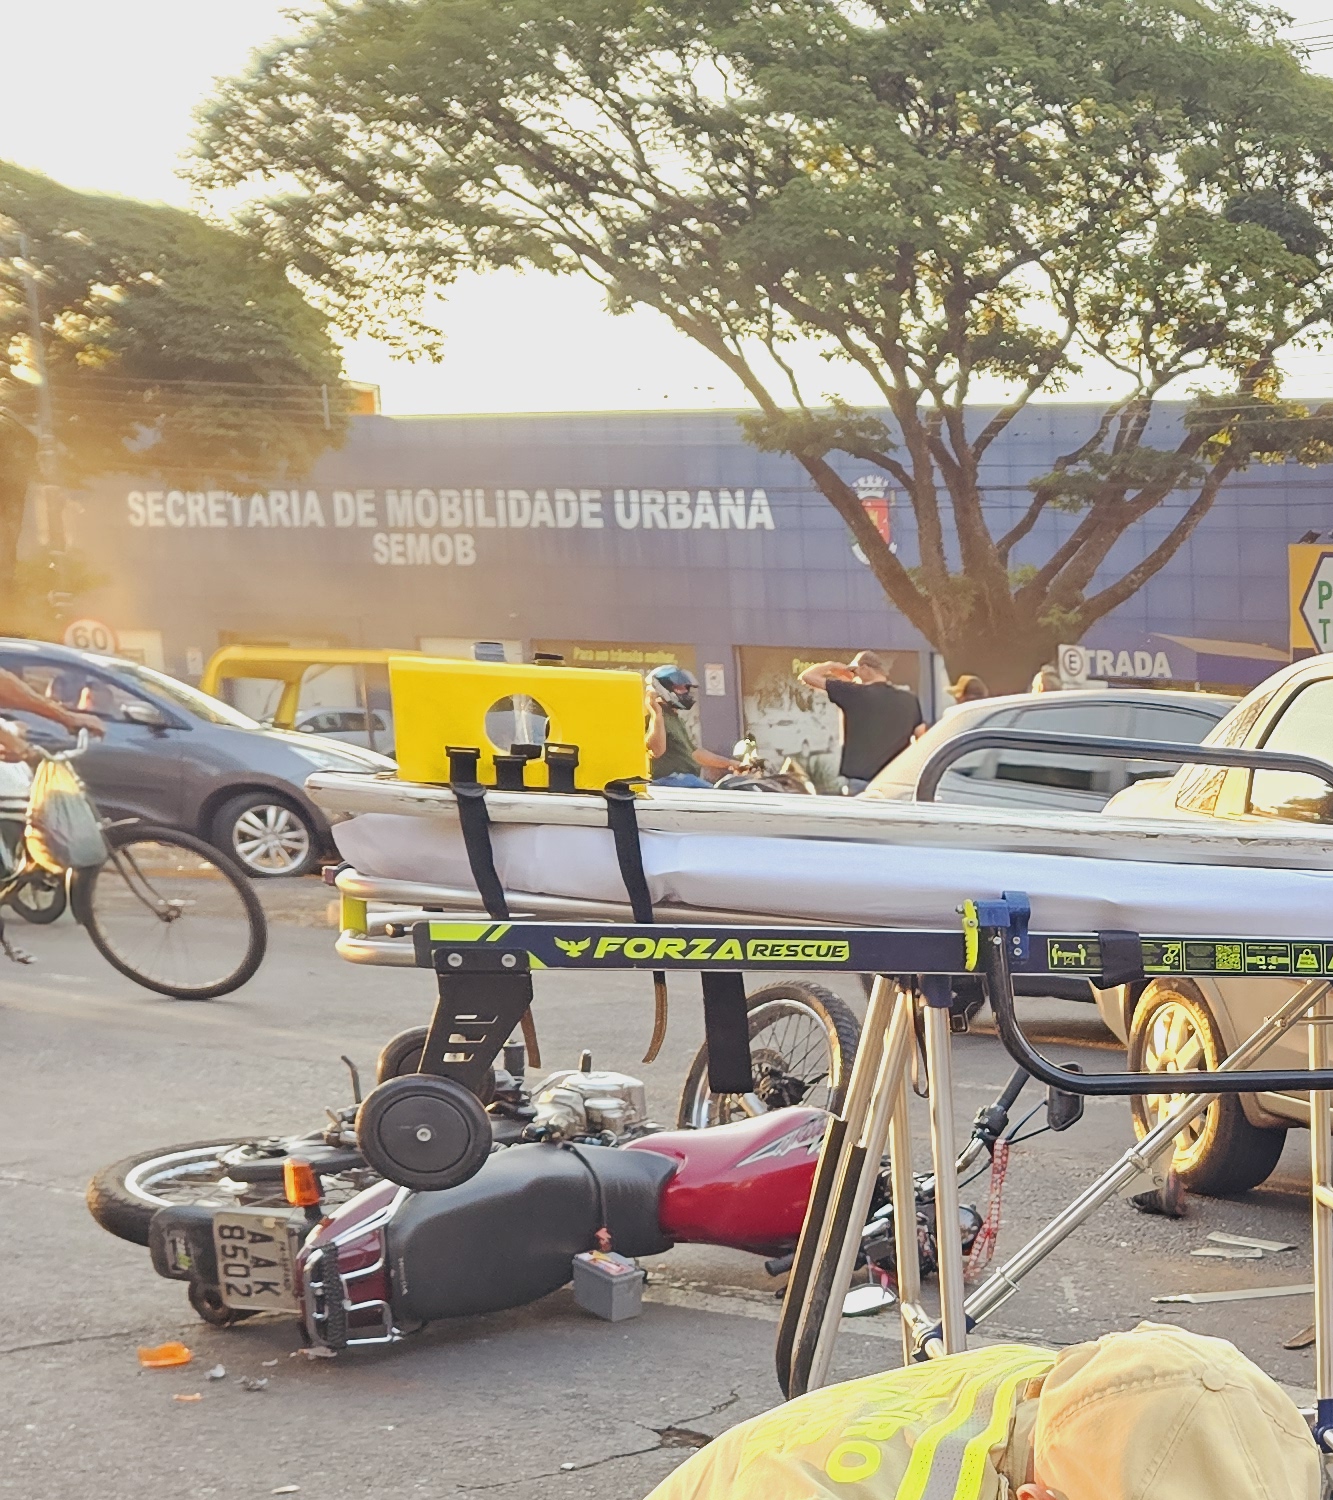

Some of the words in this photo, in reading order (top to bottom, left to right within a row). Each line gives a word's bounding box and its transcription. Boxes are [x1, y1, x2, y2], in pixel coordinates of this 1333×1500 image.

[127, 489, 326, 528] SECRETARIA
[332, 489, 378, 528] DE
[385, 488, 604, 529] MOBILIDADE
[613, 488, 776, 530] URBANA
[372, 532, 477, 567] SEMOB
[71, 625, 108, 651] 60
[1085, 649, 1173, 679] TRADA
[593, 936, 744, 961] FORZA
[751, 942, 847, 959] RESCUE
[218, 1224, 253, 1298] 8502
[246, 1229, 281, 1297] AAK
